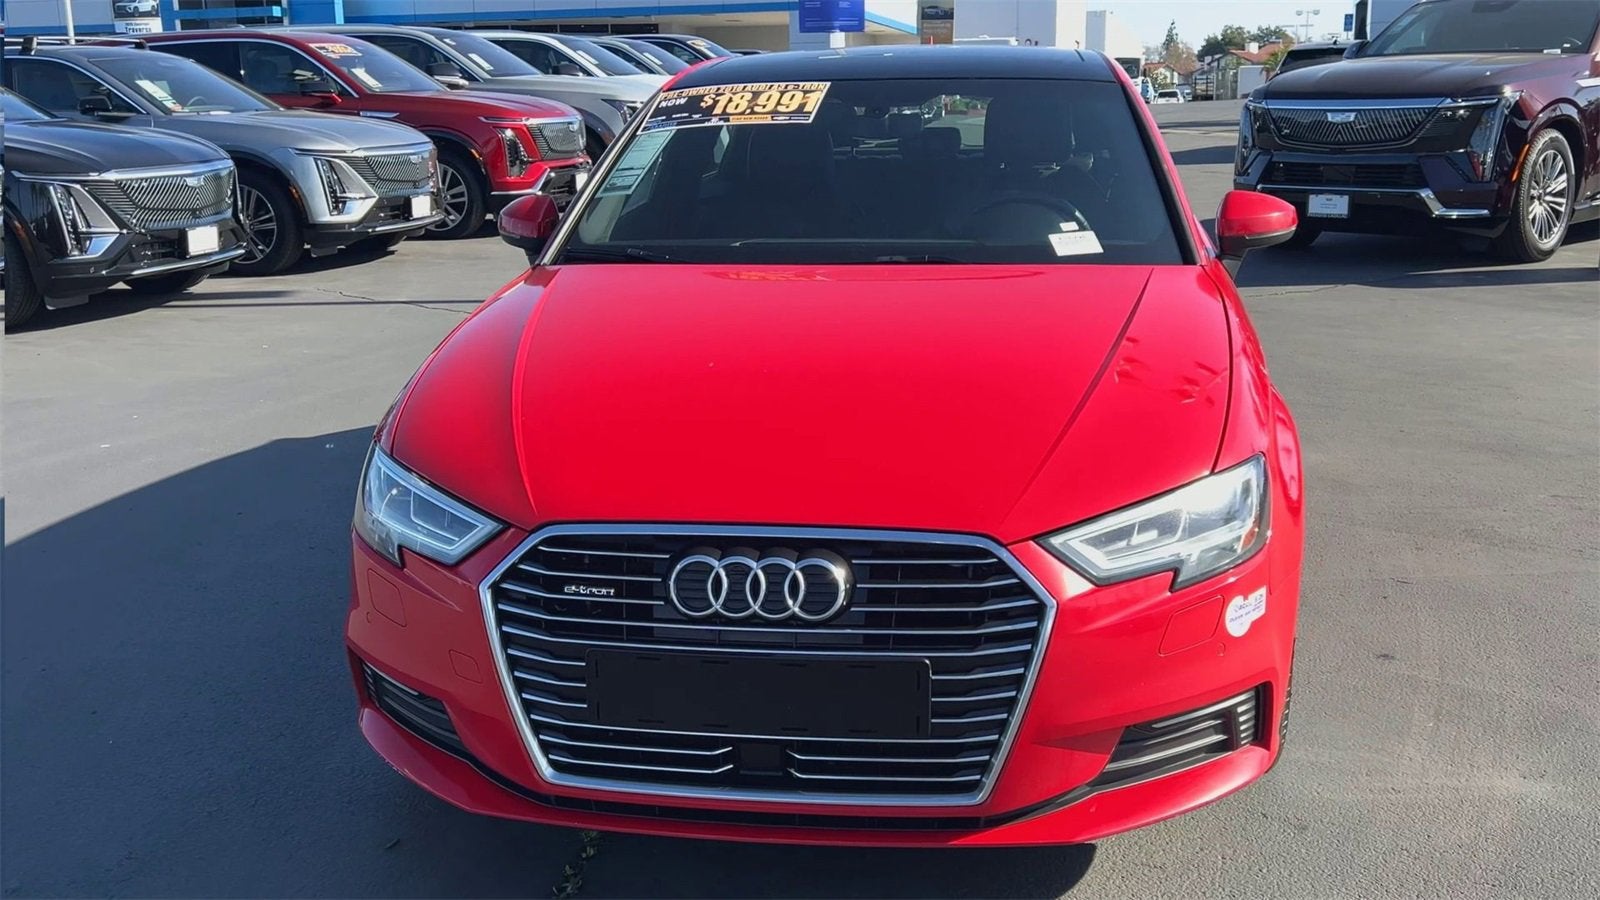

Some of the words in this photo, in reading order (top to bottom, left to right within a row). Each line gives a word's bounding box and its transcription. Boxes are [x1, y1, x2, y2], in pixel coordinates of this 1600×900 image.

[661, 87, 717, 100] PRE-OWNED
[744, 83, 769, 92] AUDI
[659, 97, 688, 109] NOW
[700, 90, 822, 115] $18,991
[564, 584, 615, 596] e-tron
